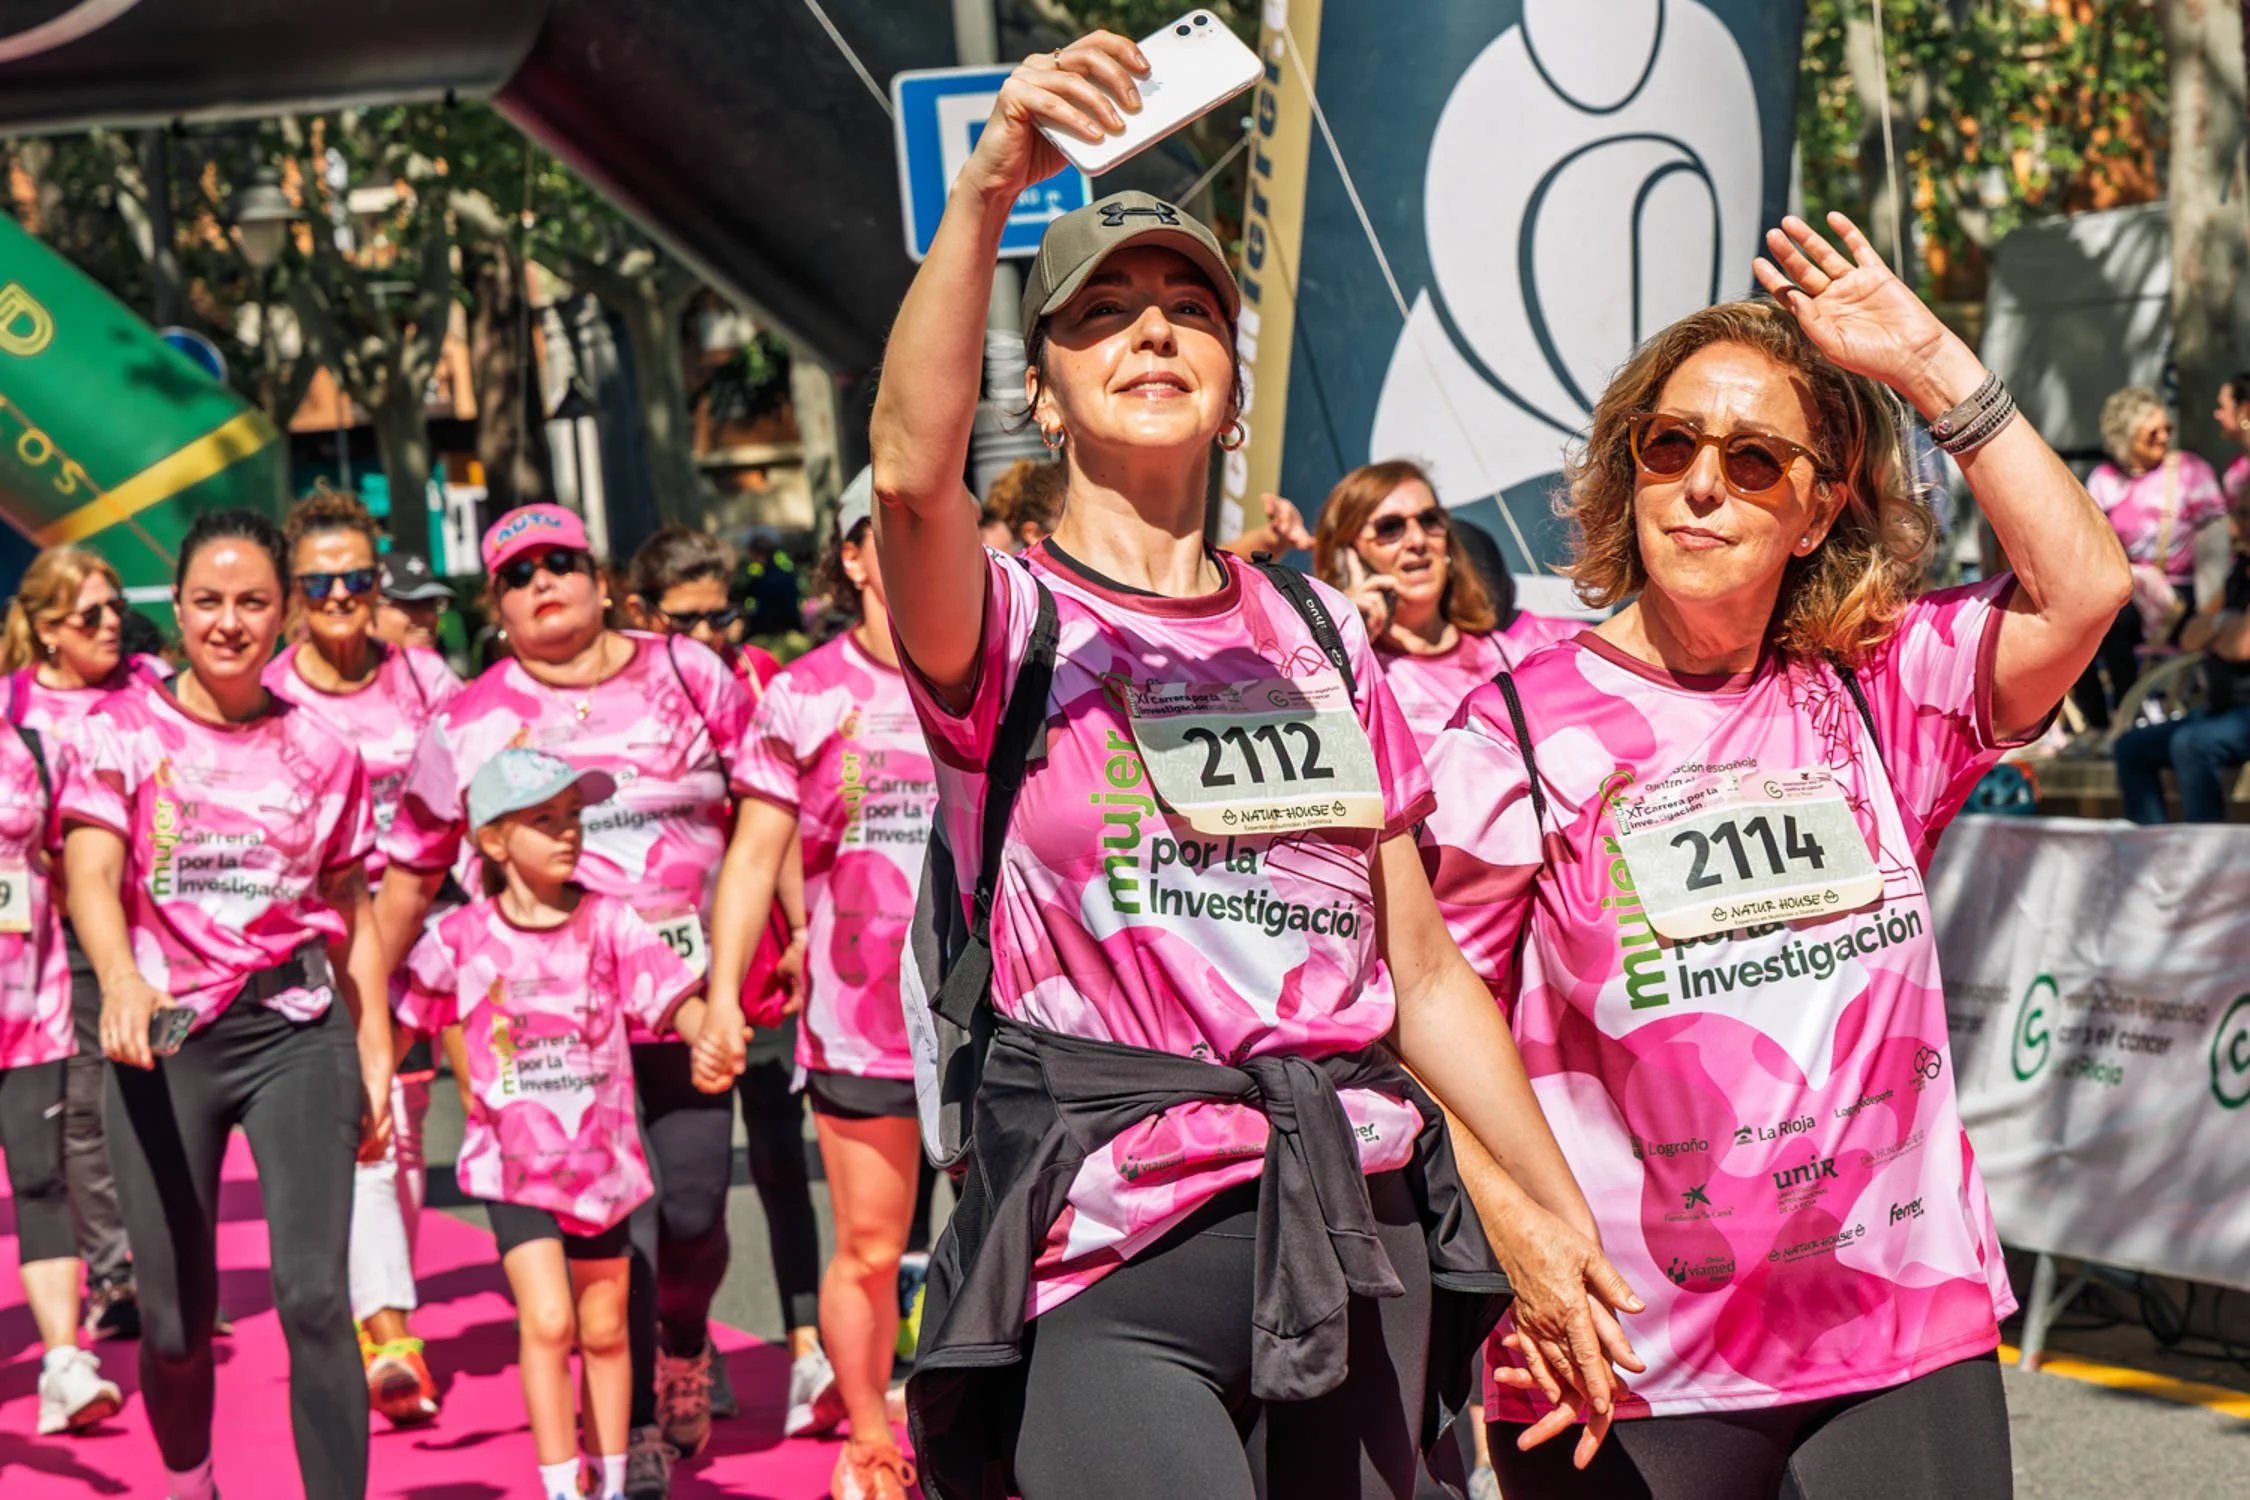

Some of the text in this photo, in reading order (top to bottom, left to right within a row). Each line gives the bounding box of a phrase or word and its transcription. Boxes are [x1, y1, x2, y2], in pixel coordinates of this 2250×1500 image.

[1151, 691, 1189, 704] Carrera
[866, 752, 885, 768] XI
[1182, 722, 1335, 788] 2112
[180, 800, 199, 818] XI
[865, 800, 922, 820] por la
[1643, 798, 1685, 815] Carrera
[1687, 791, 1705, 808] por
[1706, 787, 1719, 796] la
[1089, 729, 1156, 915] mujer
[1240, 804, 1330, 823] NATUR HOUSE
[1630, 801, 1703, 830] Invegación
[180, 825, 261, 846] Carrera
[148, 798, 182, 897] mujer
[1150, 836, 1258, 875] por la
[1670, 815, 1825, 891] 2114
[177, 852, 238, 873] por la
[1731, 894, 1821, 918] NATUR HOUSE
[1677, 907, 1924, 999] Investigación
[514, 1033, 577, 1050] Carrera
[517, 1054, 563, 1075] por la
[1757, 1114, 1817, 1142] La Rioja
[1647, 1137, 1709, 1157] Logroño
[1688, 1260, 1735, 1276] viamed
